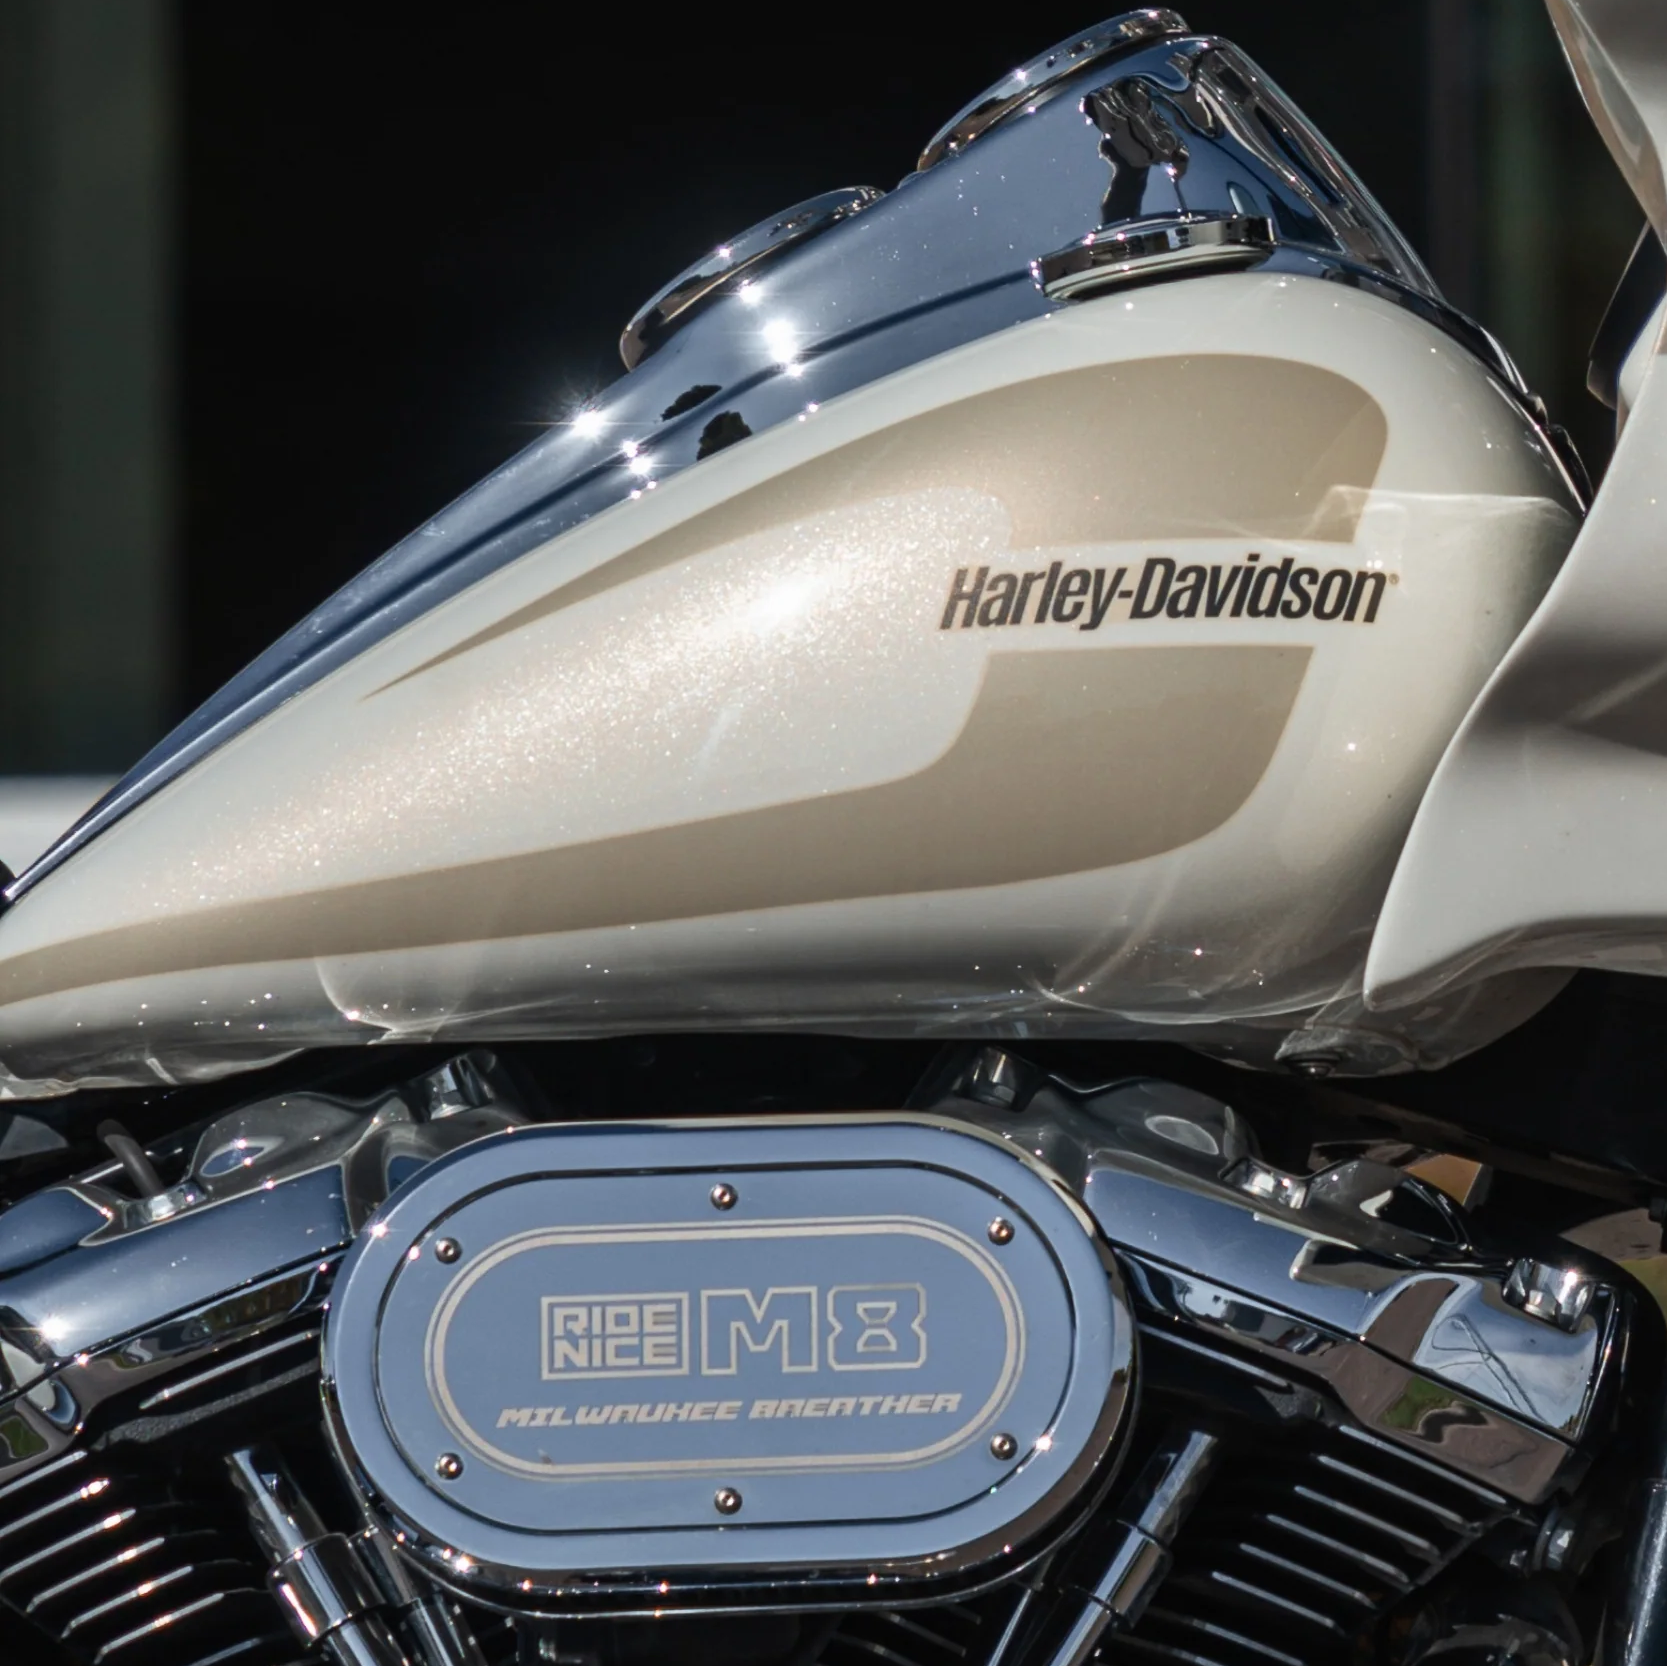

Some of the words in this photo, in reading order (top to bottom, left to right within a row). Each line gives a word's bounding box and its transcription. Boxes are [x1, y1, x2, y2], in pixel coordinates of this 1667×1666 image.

[939, 553, 1388, 631] Harley-Davidson
[552, 1302, 678, 1336] RIDE
[701, 1283, 926, 1375] M8
[552, 1334, 678, 1368] NICE
[496, 1401, 743, 1428] MILWAUKEE
[748, 1393, 962, 1421] BREATHER
